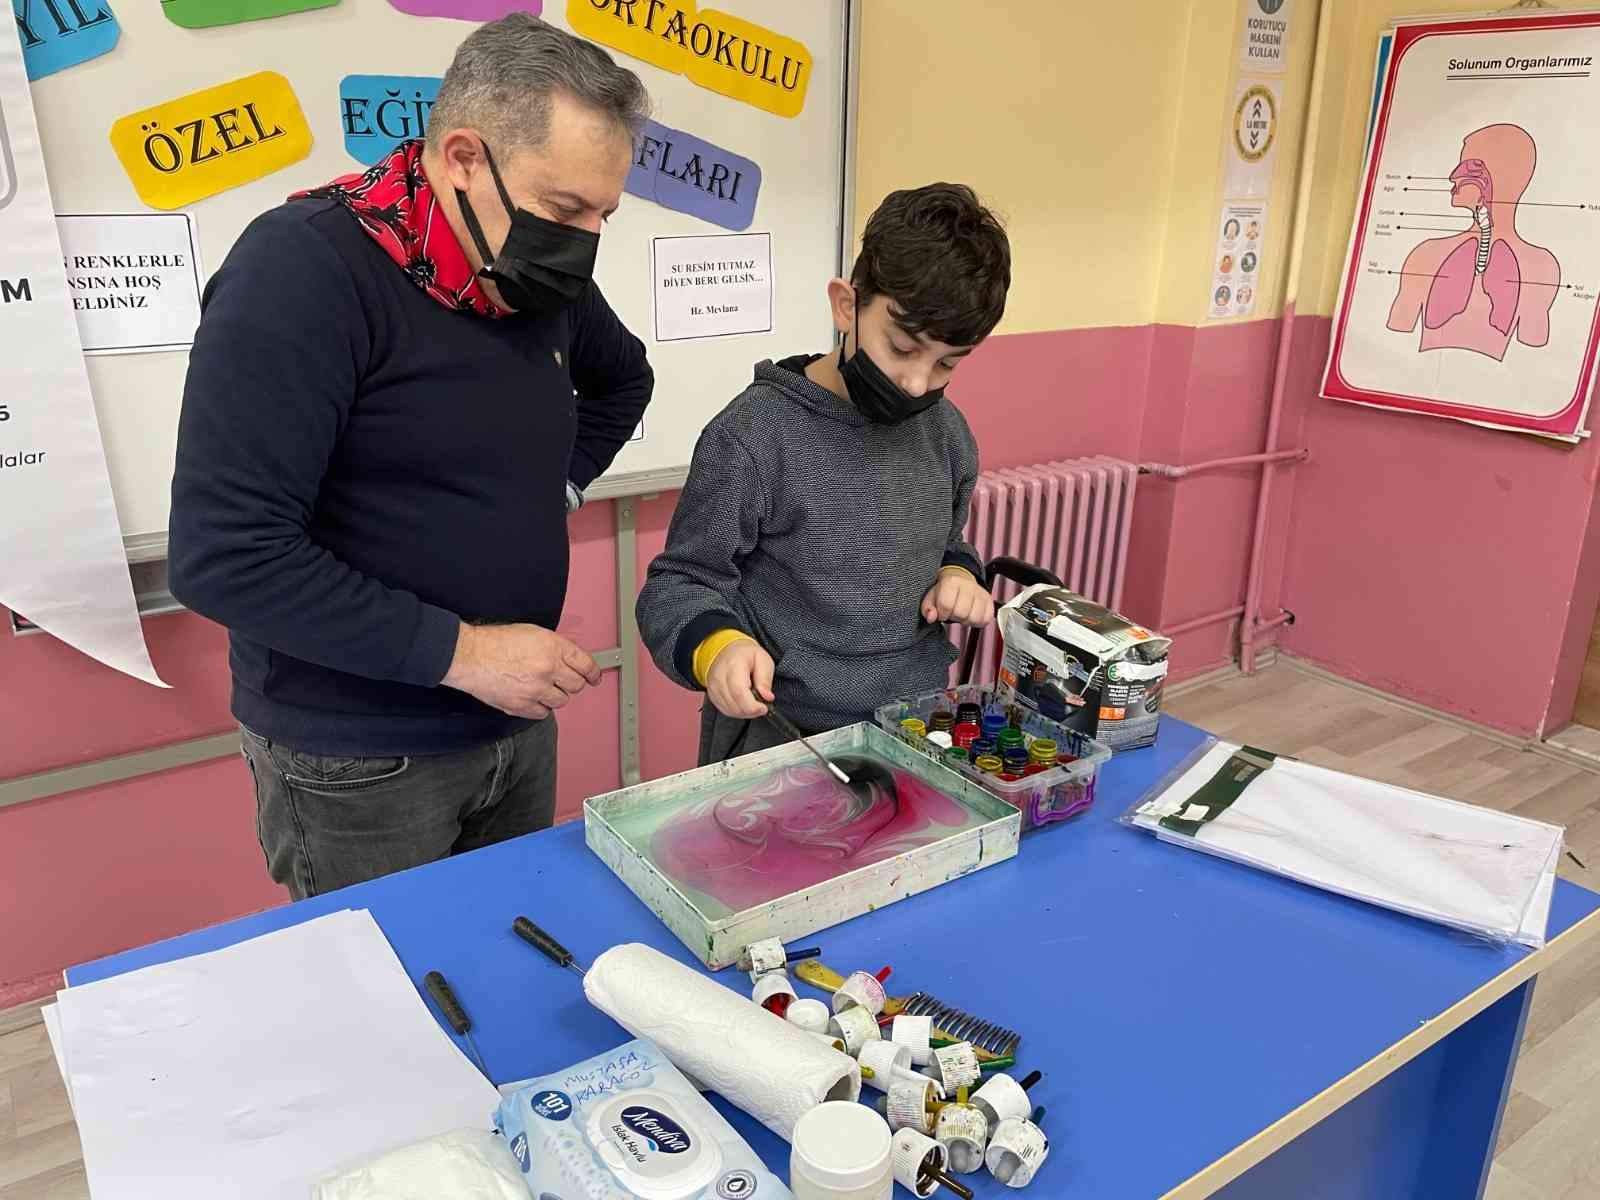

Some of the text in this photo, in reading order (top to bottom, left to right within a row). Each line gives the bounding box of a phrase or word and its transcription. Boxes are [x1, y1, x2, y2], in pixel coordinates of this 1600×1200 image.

[590, 0, 803, 92] RTAOKULU
[1248, 46, 1280, 59] KULLAN
[1448, 55, 1593, 71] Solunum Organlarımız
[142, 101, 287, 175] ÖZEL
[74, 254, 185, 269] RENKLERLE
[672, 260, 756, 273] SU RESİM TUTMAZ
[125, 275, 161, 290] HOŞ
[707, 304, 739, 314] Mevlana
[542, 1092, 569, 1113] 101
[624, 1111, 688, 1151] Mendiva
[625, 1139, 647, 1163] Havlu
